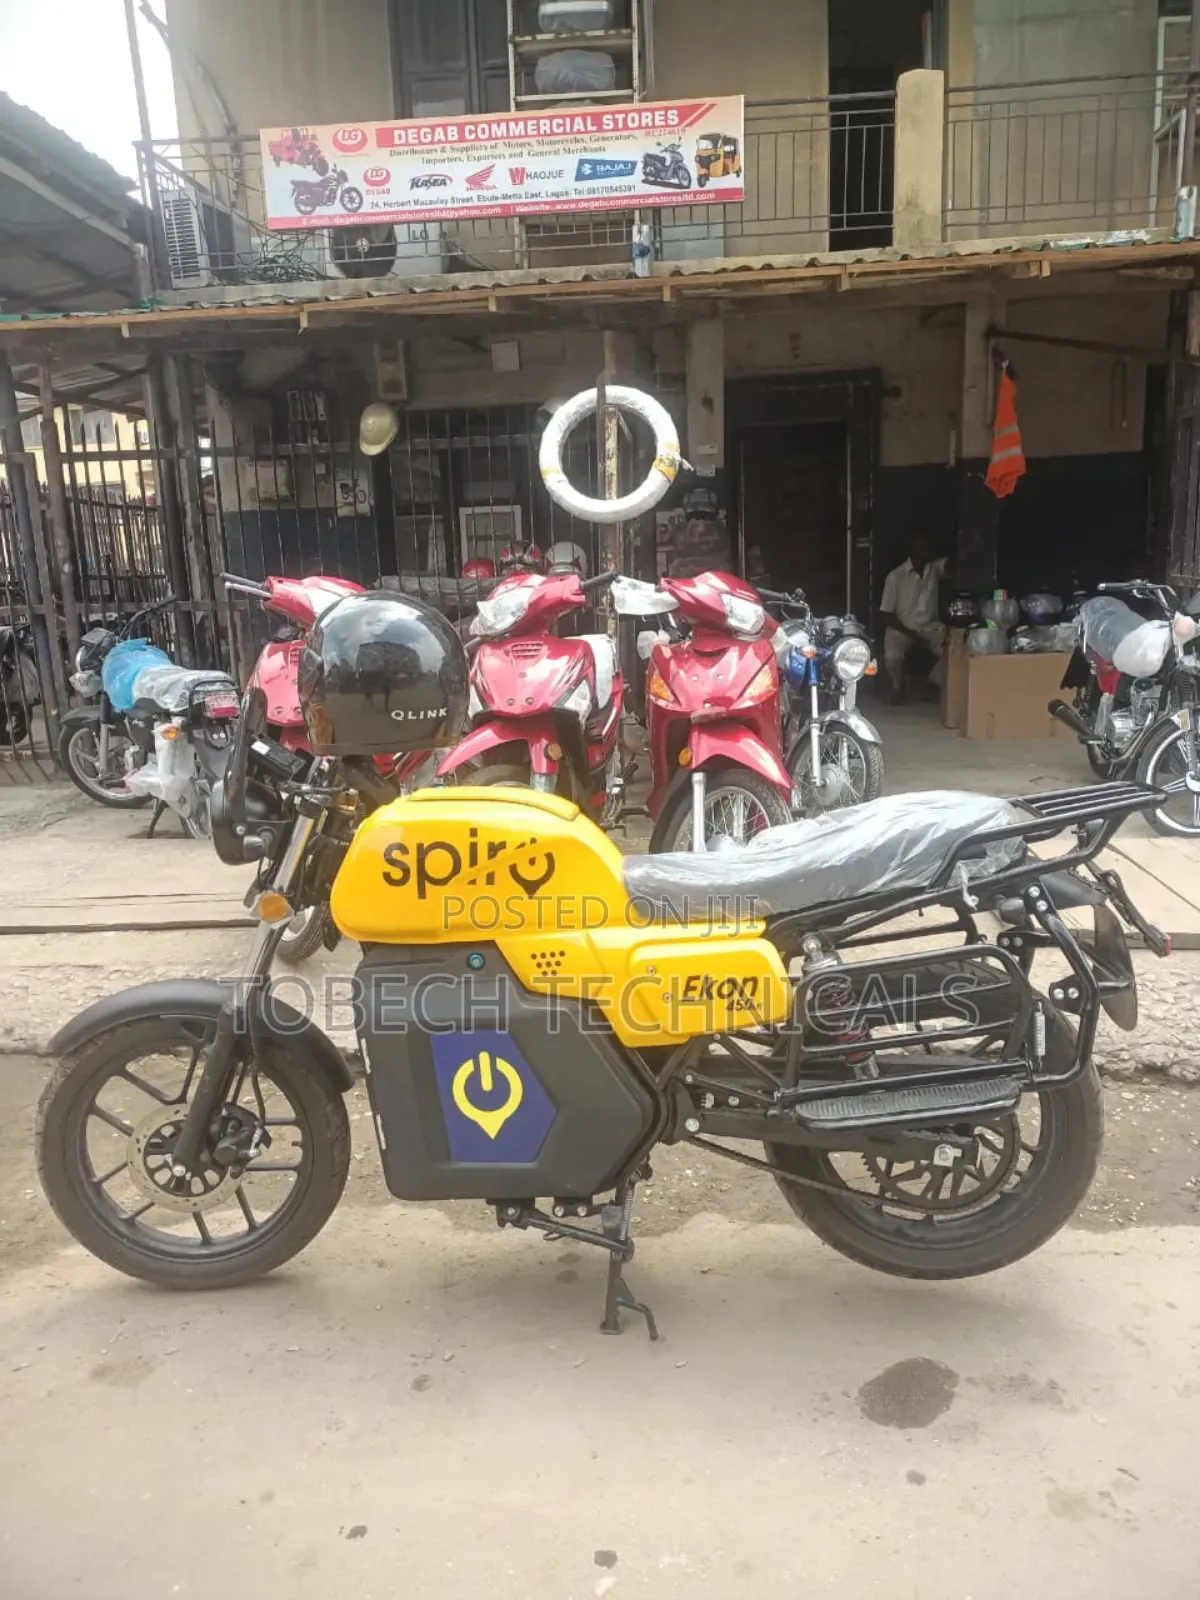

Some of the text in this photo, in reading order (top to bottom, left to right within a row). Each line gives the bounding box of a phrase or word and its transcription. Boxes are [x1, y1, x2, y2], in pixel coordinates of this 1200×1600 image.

[393, 109, 680, 145] DEGAB COMMERCIAL STORES
[440, 146, 447, 154] &
[450, 144, 487, 155] Suppliers
[502, 140, 534, 150] Motors,
[589, 133, 638, 144] Generators,
[422, 155, 464, 166] Importers,
[467, 153, 506, 163] Exporters
[563, 146, 606, 156] Merchants
[596, 163, 631, 172] BAJAJ
[384, 199, 411, 209] Herbert
[391, 707, 448, 720] QLINK
[382, 827, 556, 899] spiro
[681, 975, 759, 1002] Ekon
